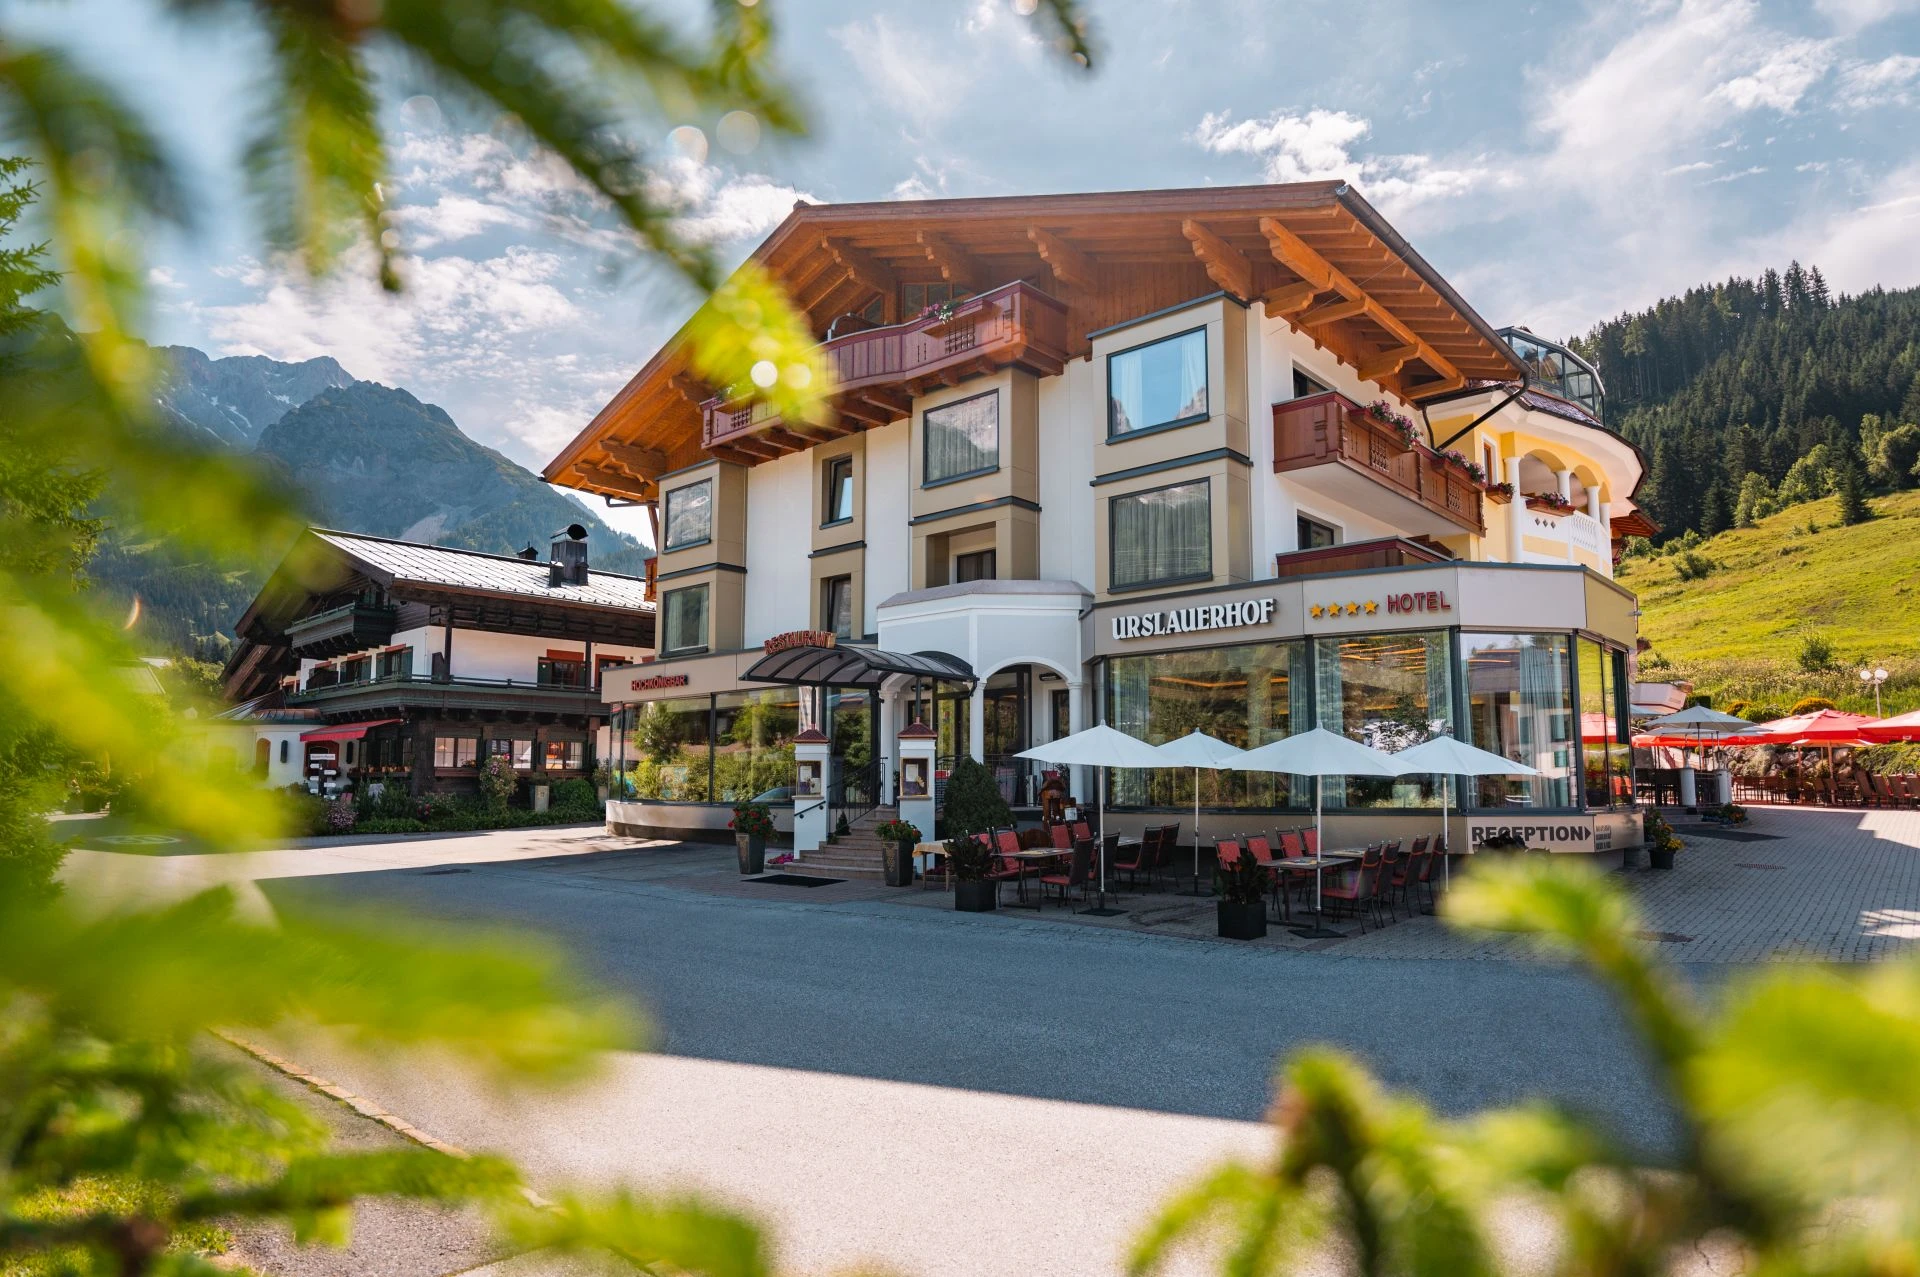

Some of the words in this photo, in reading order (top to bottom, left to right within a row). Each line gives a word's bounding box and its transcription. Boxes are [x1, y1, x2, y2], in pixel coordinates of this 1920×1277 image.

[1112, 598, 1274, 640] URSLAUERHOF
[1387, 591, 1451, 614] HOTEL
[764, 630, 833, 655] RESTAURANT
